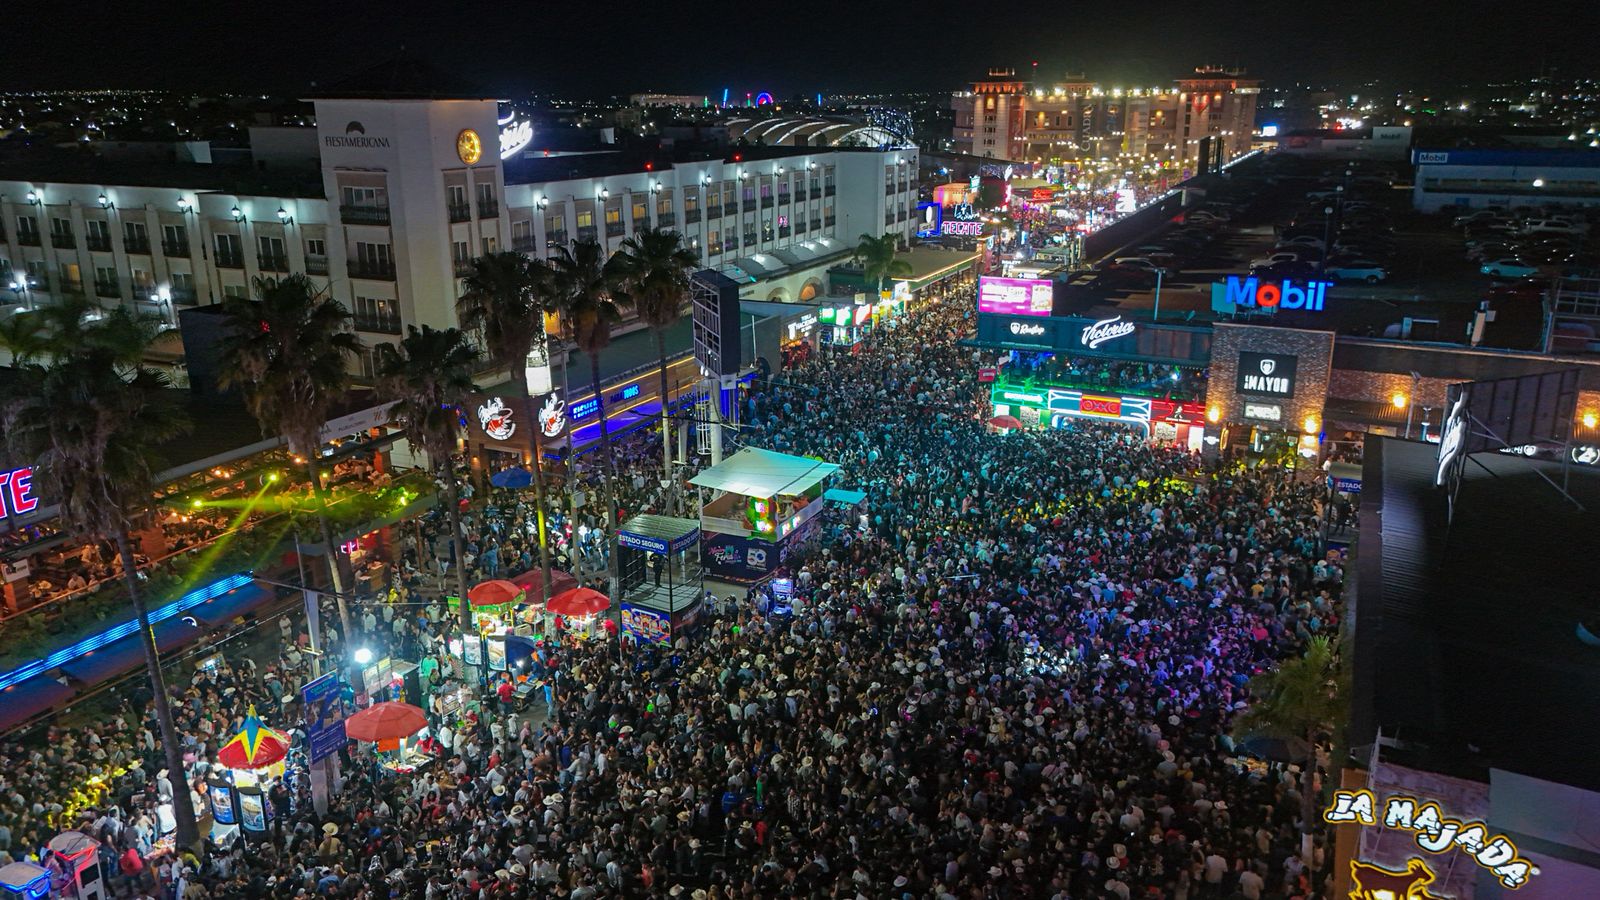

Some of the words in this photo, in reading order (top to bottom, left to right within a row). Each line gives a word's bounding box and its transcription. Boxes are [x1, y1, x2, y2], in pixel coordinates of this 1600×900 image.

[325, 136, 390, 148] FIESTAMERICANA
[1420, 153, 1446, 162] Mobil
[942, 221, 983, 236] TECATE
[1225, 275, 1326, 311] Mobil
[1081, 315, 1135, 349] Victoria
[619, 533, 642, 546] ESTADO
[640, 539, 665, 551] SEGURO
[1324, 790, 1376, 824] LA
[1383, 797, 1532, 889] MAJADA
